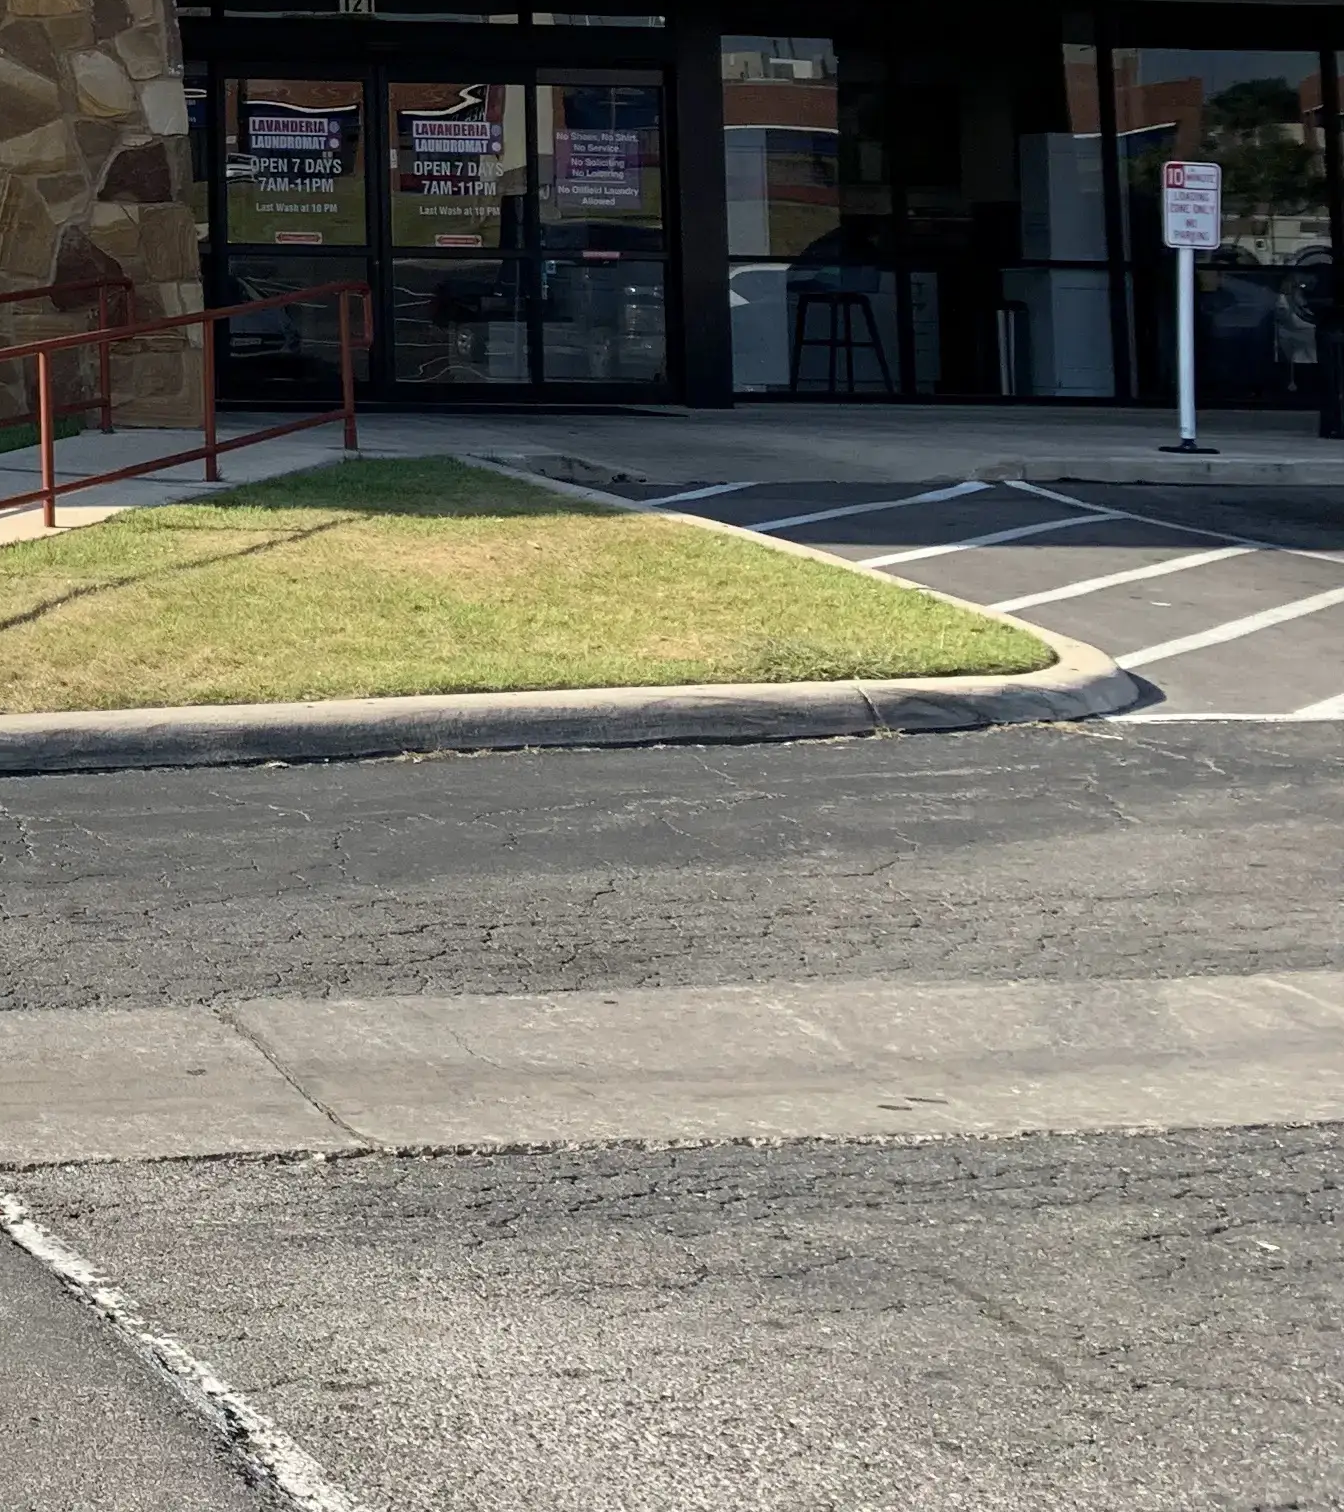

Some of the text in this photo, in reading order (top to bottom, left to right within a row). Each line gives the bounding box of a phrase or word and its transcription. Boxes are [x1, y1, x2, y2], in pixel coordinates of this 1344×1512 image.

[252, 119, 325, 133] LAVANDERIA
[415, 123, 488, 137] LAVANDERIA
[252, 136, 326, 149] LAUNDROMAT
[556, 132, 568, 140] No
[601, 133, 613, 141] No
[415, 139, 488, 152] LAUNDROMAT
[251, 157, 342, 173] OPEN 7 DAYS
[414, 161, 504, 176] OPEN 7 DAYS
[571, 158, 583, 166] No
[1167, 168, 1184, 186] 10
[258, 178, 334, 192] 7AM-11PM
[421, 181, 496, 195] 7AM-11PM
[558, 186, 570, 194] No
[604, 187, 639, 196] Laundry
[256, 202, 337, 212] Last Wash at 10 PM
[581, 197, 616, 205] Allowed
[419, 206, 500, 216] Last Wash at 10 PM
